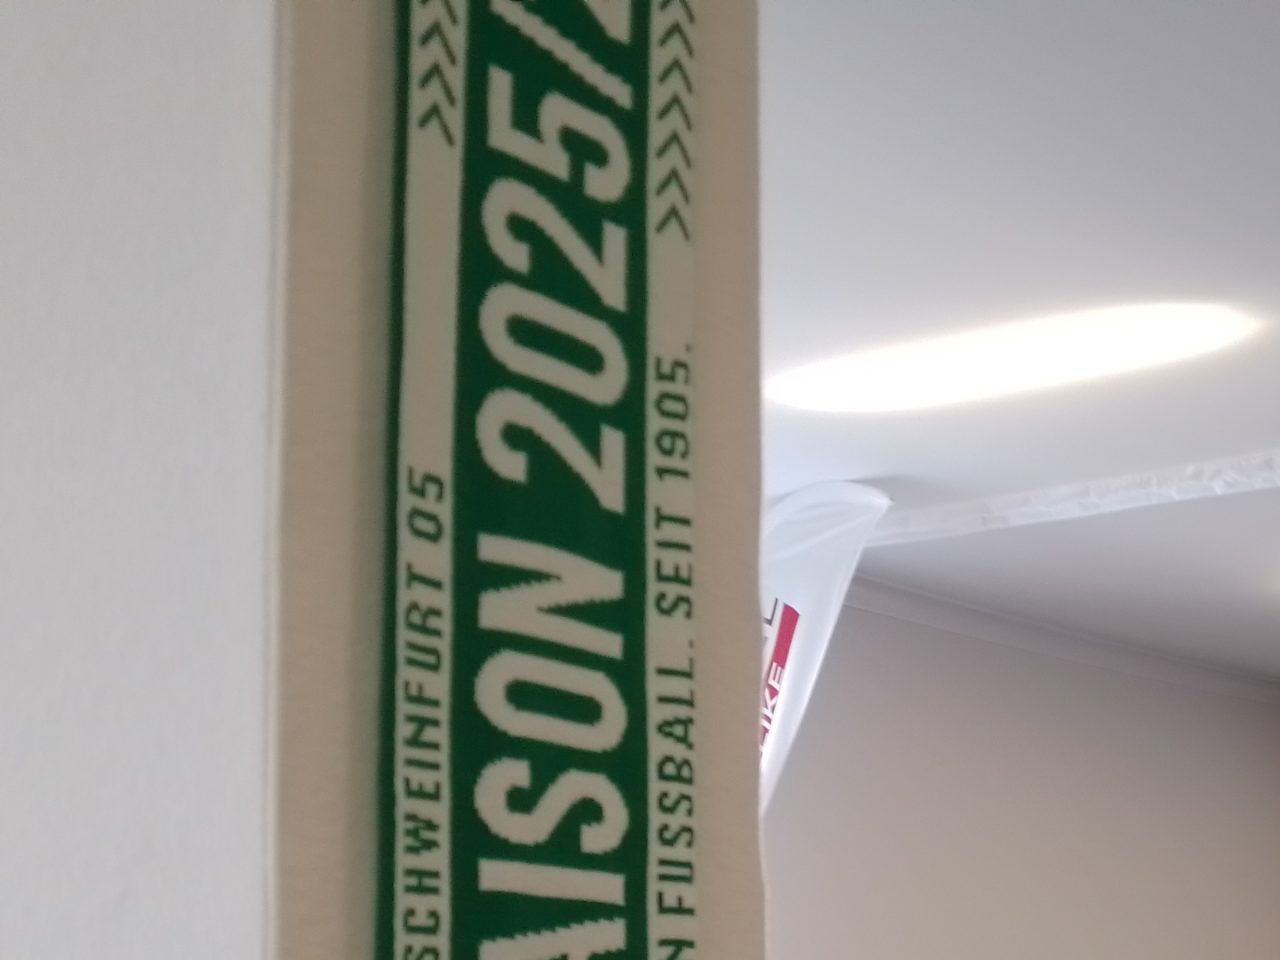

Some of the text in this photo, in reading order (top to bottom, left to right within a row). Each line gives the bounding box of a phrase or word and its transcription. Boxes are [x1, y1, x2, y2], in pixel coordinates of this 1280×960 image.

[475, 0, 634, 515] 2025/
[655, 344, 692, 479] 1905.
[407, 465, 446, 543] 05
[656, 507, 694, 619] SEIT
[656, 641, 697, 916] FUSSBALL.
